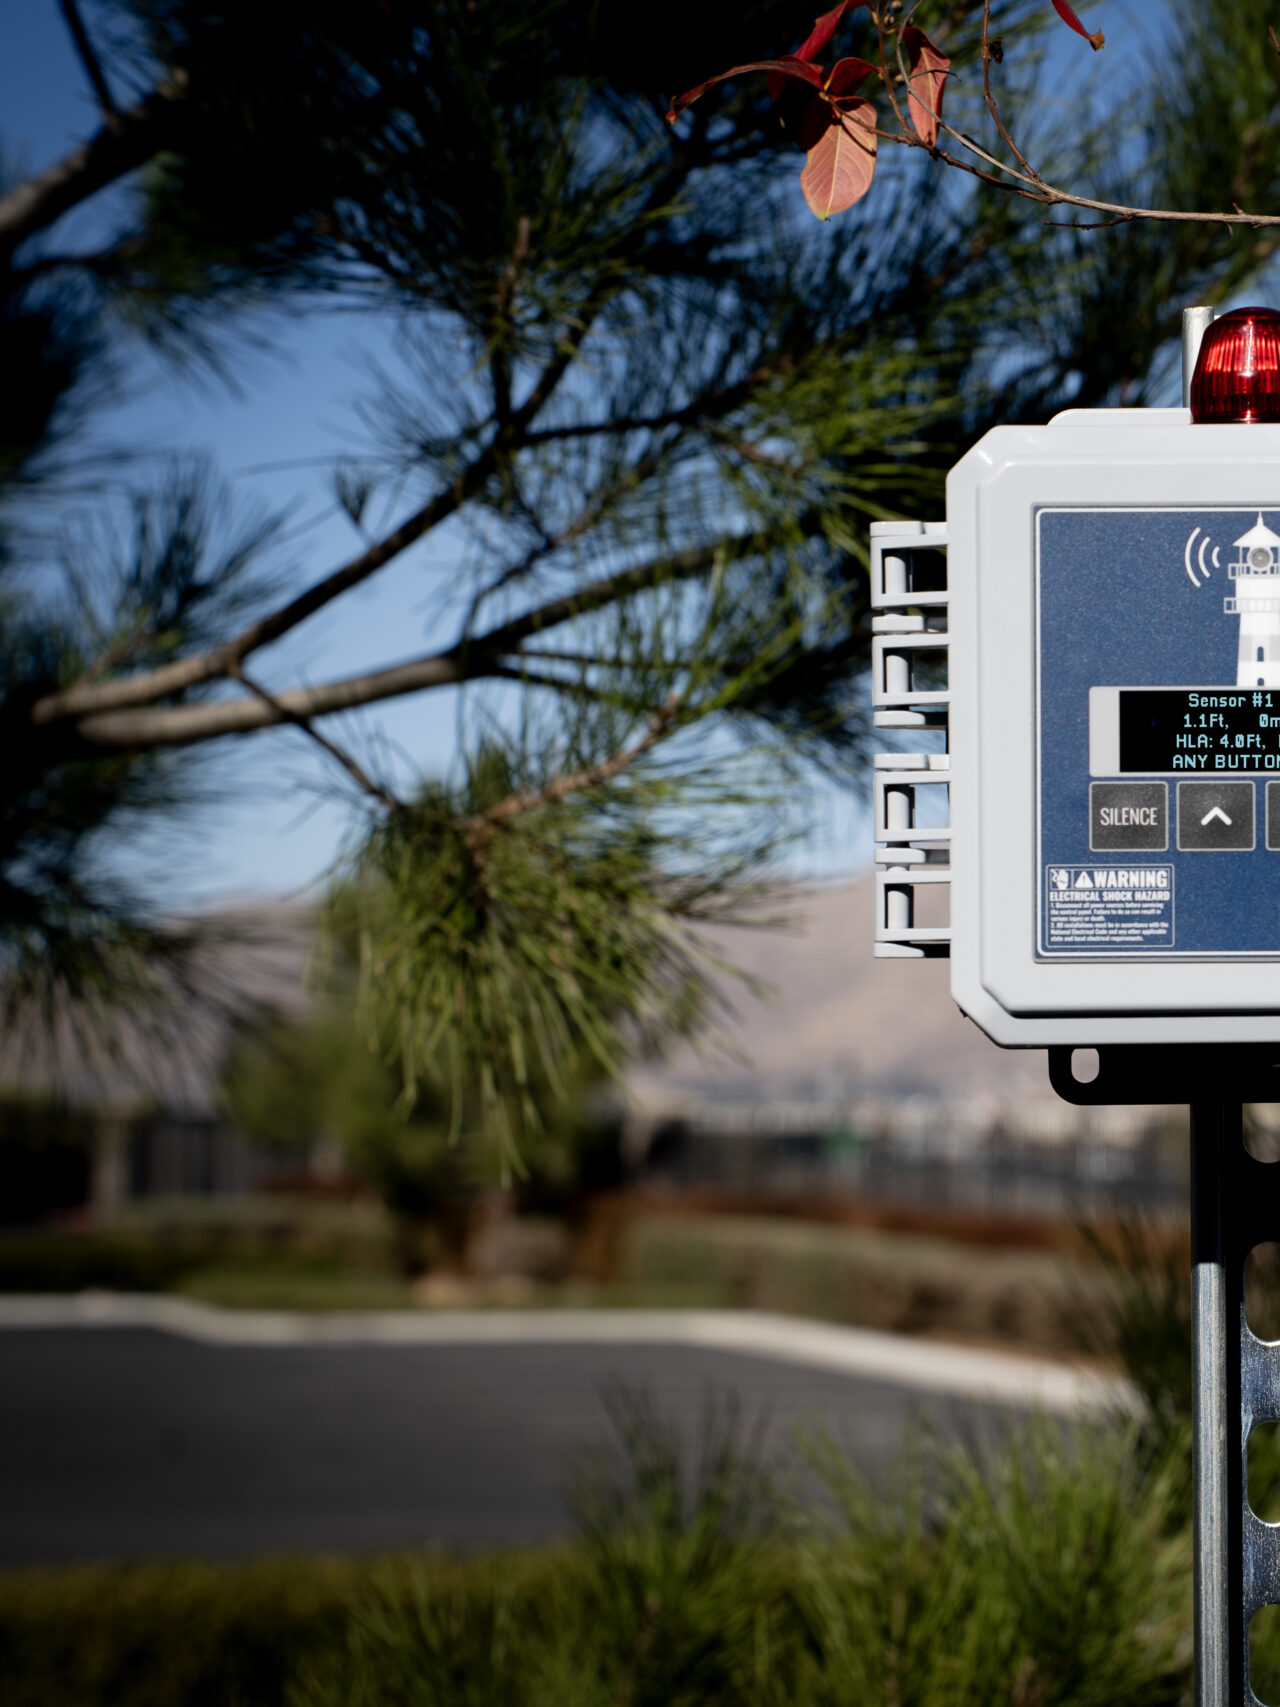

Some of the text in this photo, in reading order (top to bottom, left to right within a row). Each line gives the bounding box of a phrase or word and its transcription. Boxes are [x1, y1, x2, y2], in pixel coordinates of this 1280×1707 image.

[1188, 693, 1246, 708] Sensor
[1252, 692, 1273, 708] #1
[1183, 713, 1229, 730] 1.1Ft,
[1176, 734, 1213, 748] HLA:
[1220, 734, 1266, 750] 4.0Ft,
[1172, 754, 1208, 769] ANY
[1100, 807, 1158, 826] SILENCE
[1093, 870, 1168, 888] WARNING
[1049, 891, 1171, 901] ELECTRICAL SHOCK HAZARD
